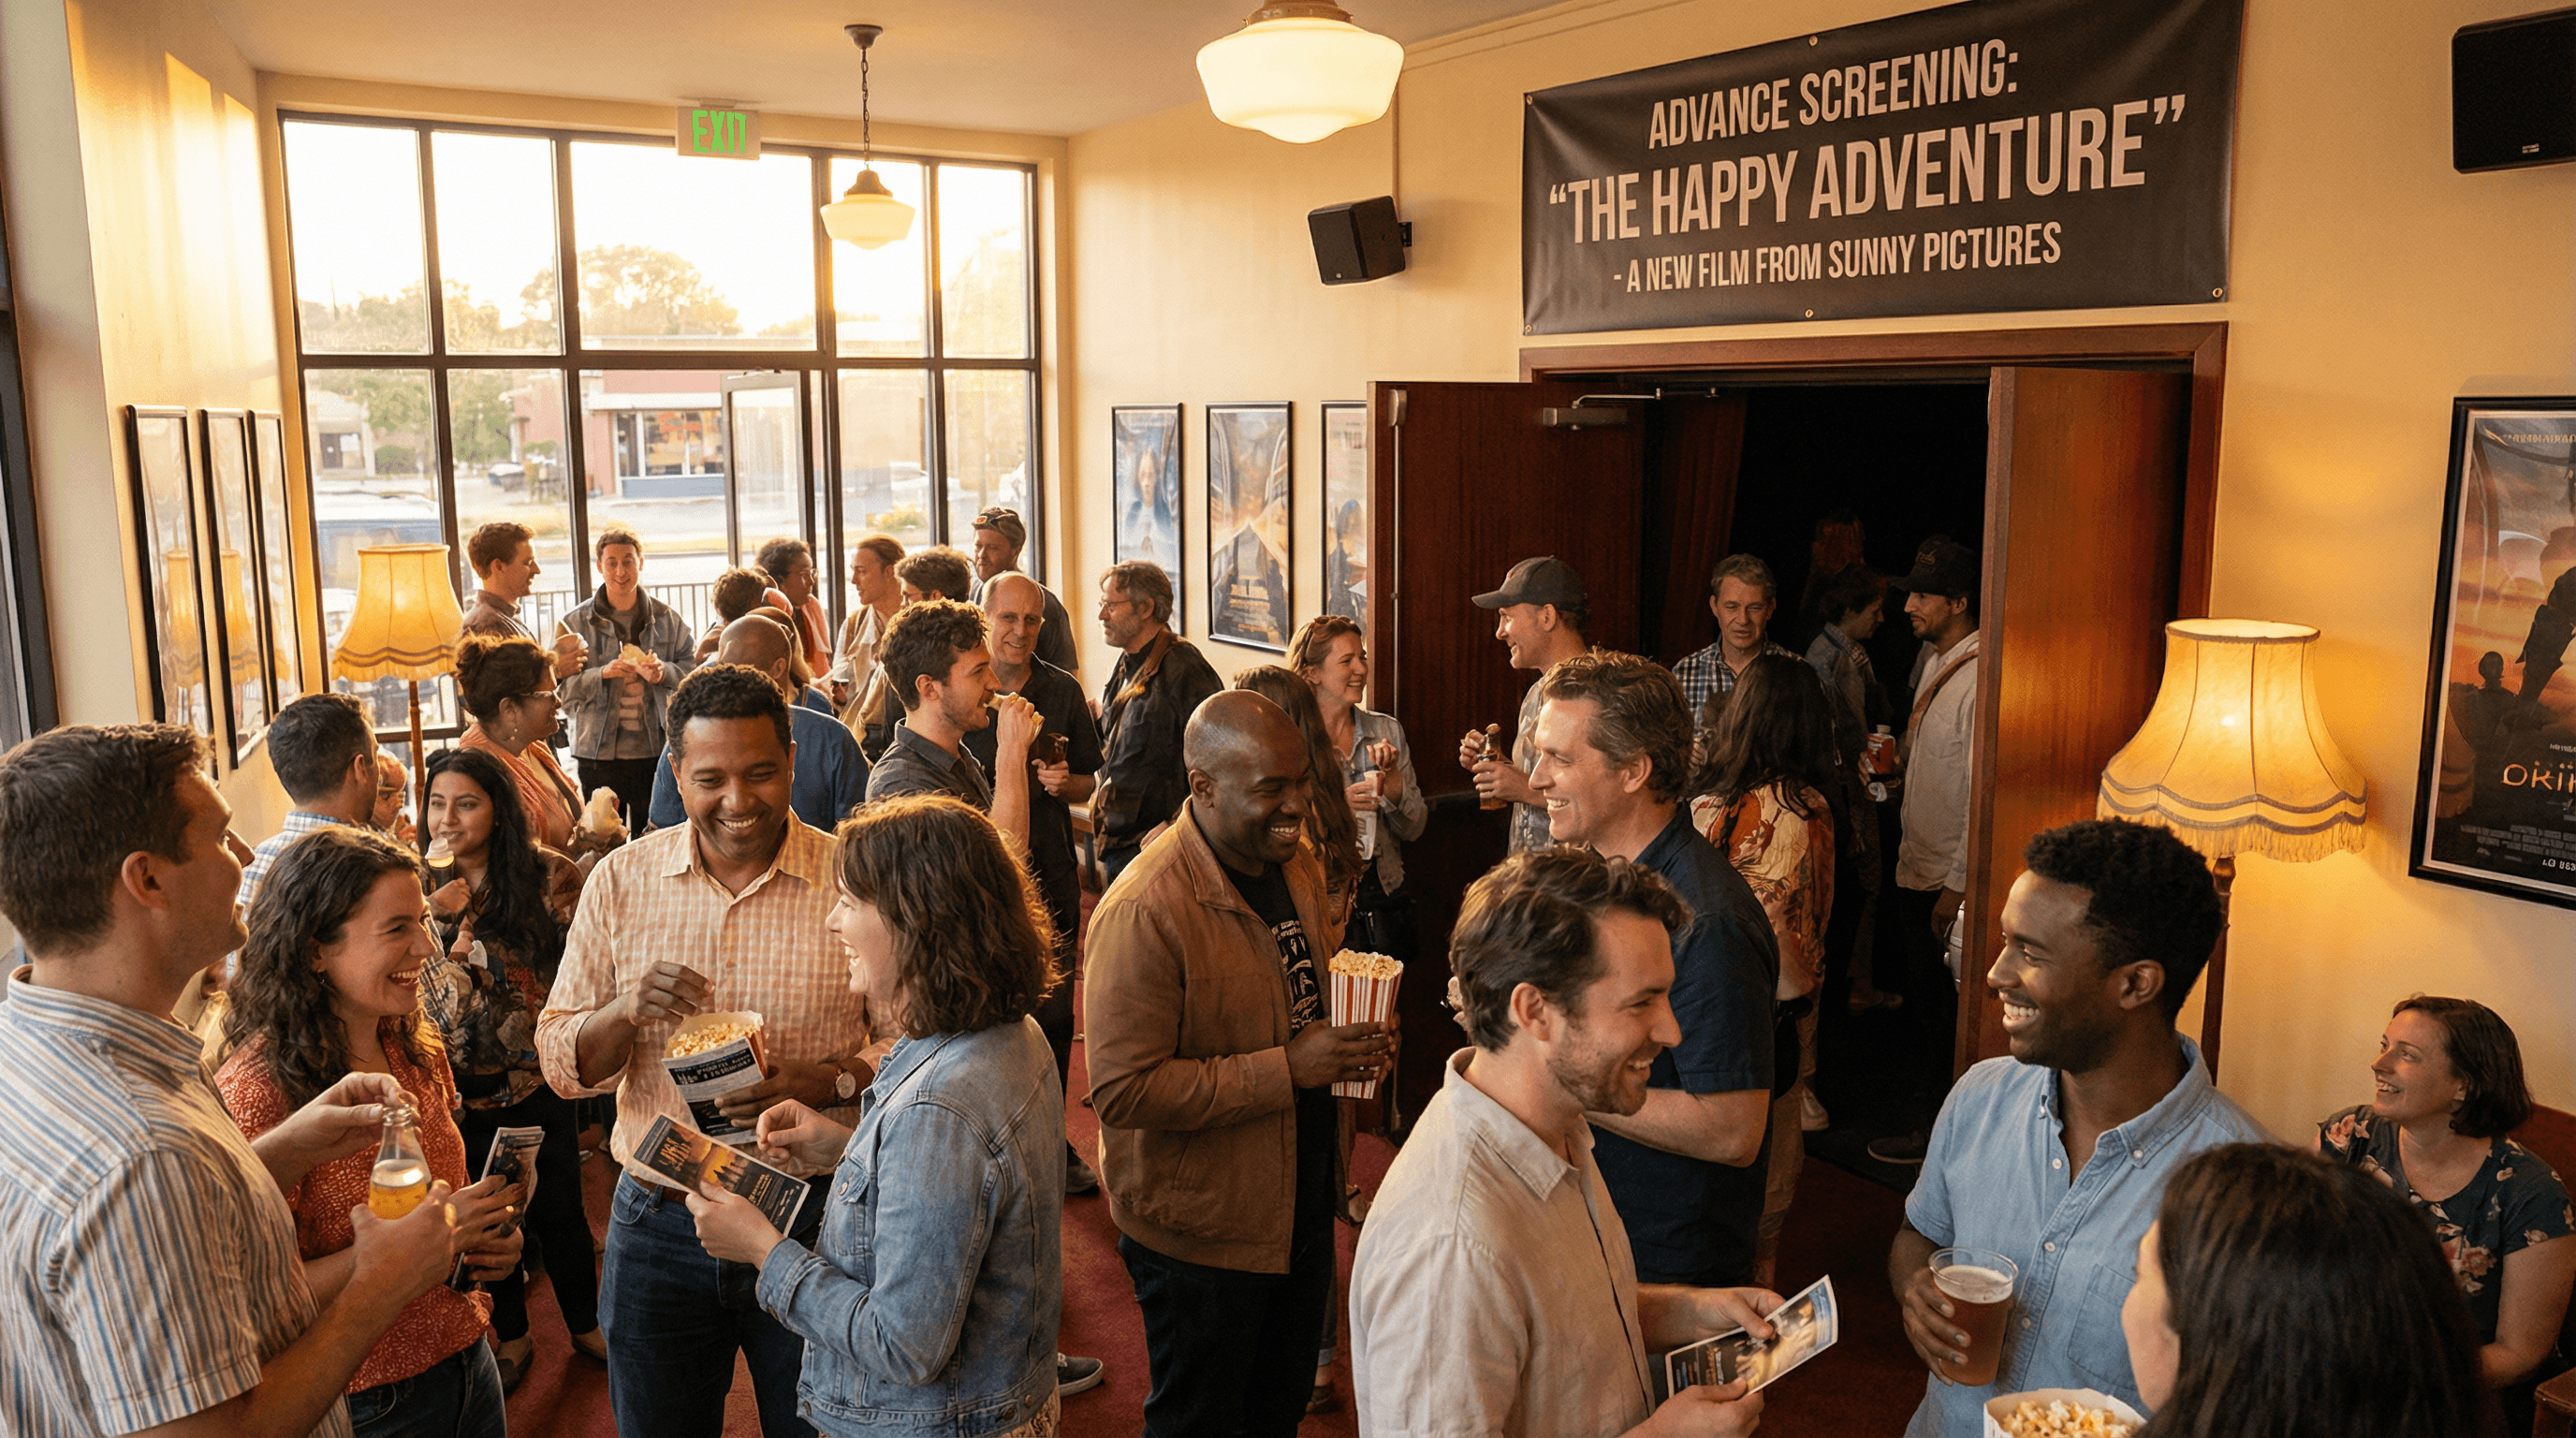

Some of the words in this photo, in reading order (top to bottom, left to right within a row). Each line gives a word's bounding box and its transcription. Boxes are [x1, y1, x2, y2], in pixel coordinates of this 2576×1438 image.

[1648, 79, 1790, 150] ADVANCE
[1799, 38, 2018, 125] SCREENING:
[1549, 173, 1641, 243] “THE
[1652, 150, 1799, 236] HAPPY
[1808, 94, 2186, 220] ADVENTURE”
[1626, 258, 1642, 294] A
[1646, 252, 1693, 292] NEW
[1699, 246, 1749, 288] FILM
[1755, 242, 1822, 285] FROM
[1828, 232, 1917, 279] SUNNY
[1923, 221, 2062, 272] PICTURES
